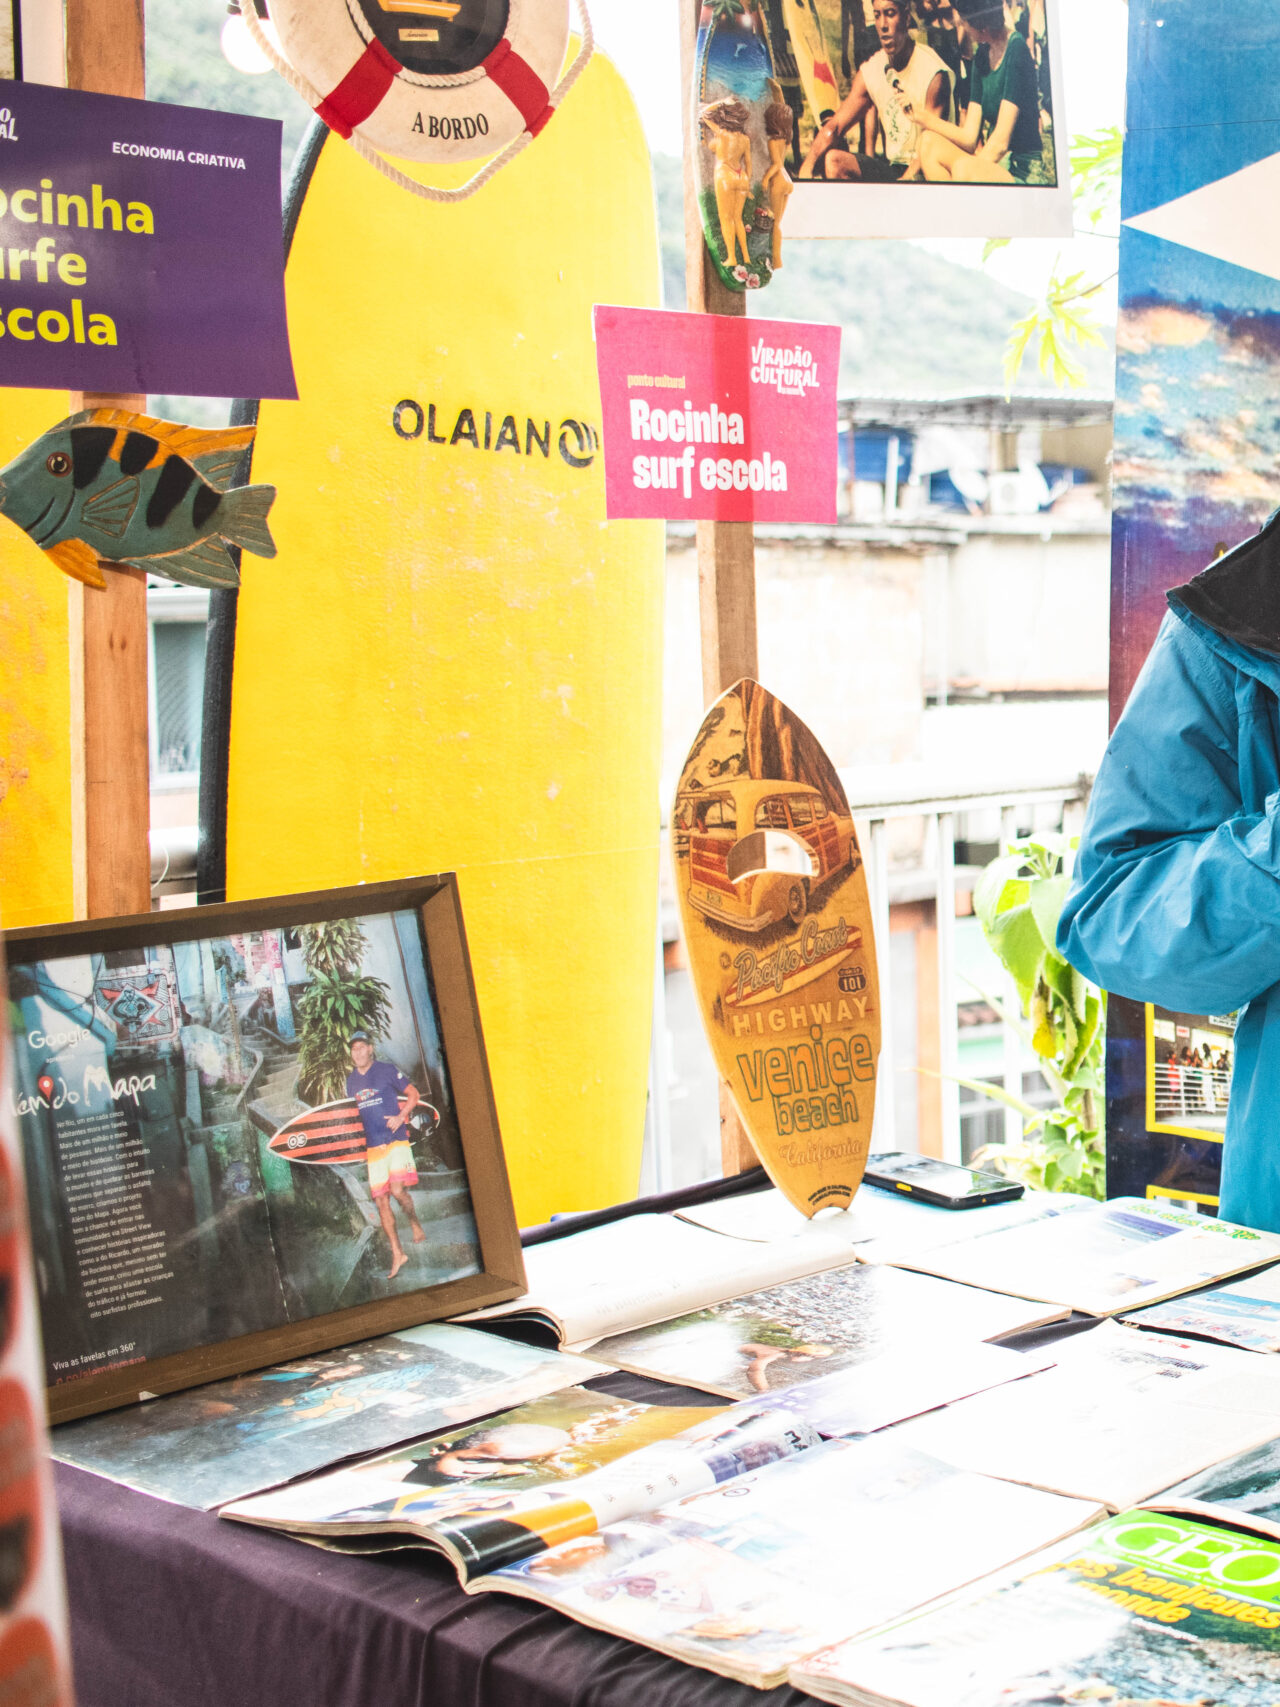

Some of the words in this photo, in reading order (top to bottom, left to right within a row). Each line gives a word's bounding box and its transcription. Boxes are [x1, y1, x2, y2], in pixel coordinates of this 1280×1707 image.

[411, 111, 425, 134] A
[428, 113, 489, 140] BORDO
[112, 141, 186, 162] ECONOMIA
[188, 152, 246, 170] CRIATIVA
[0, 178, 154, 235] cinha
[751, 338, 812, 368] VIRADÃO
[627, 374, 653, 388] ponto
[655, 374, 686, 389] cultural
[751, 363, 819, 396] CULTURAL
[392, 398, 551, 458] OLAIAN
[630, 399, 745, 445] Rocinha
[632, 446, 695, 498] surf
[699, 452, 788, 492] escola
[733, 941, 800, 1000] Pacific
[801, 916, 849, 965] Coast
[843, 978, 862, 992] 101
[28, 1024, 93, 1049] Google
[733, 996, 868, 1038] HIGHWAY
[737, 1024, 875, 1102] venice
[53, 1077, 80, 1110] do
[84, 1064, 157, 1107] Mapa
[772, 1084, 859, 1136] beach
[779, 1138, 863, 1169] California
[53, 1361, 69, 1371] Viva
[71, 1358, 79, 1366] as
[80, 1351, 106, 1364] favelas
[107, 1348, 119, 1357] em
[1076, 1581, 1191, 1623] monde
